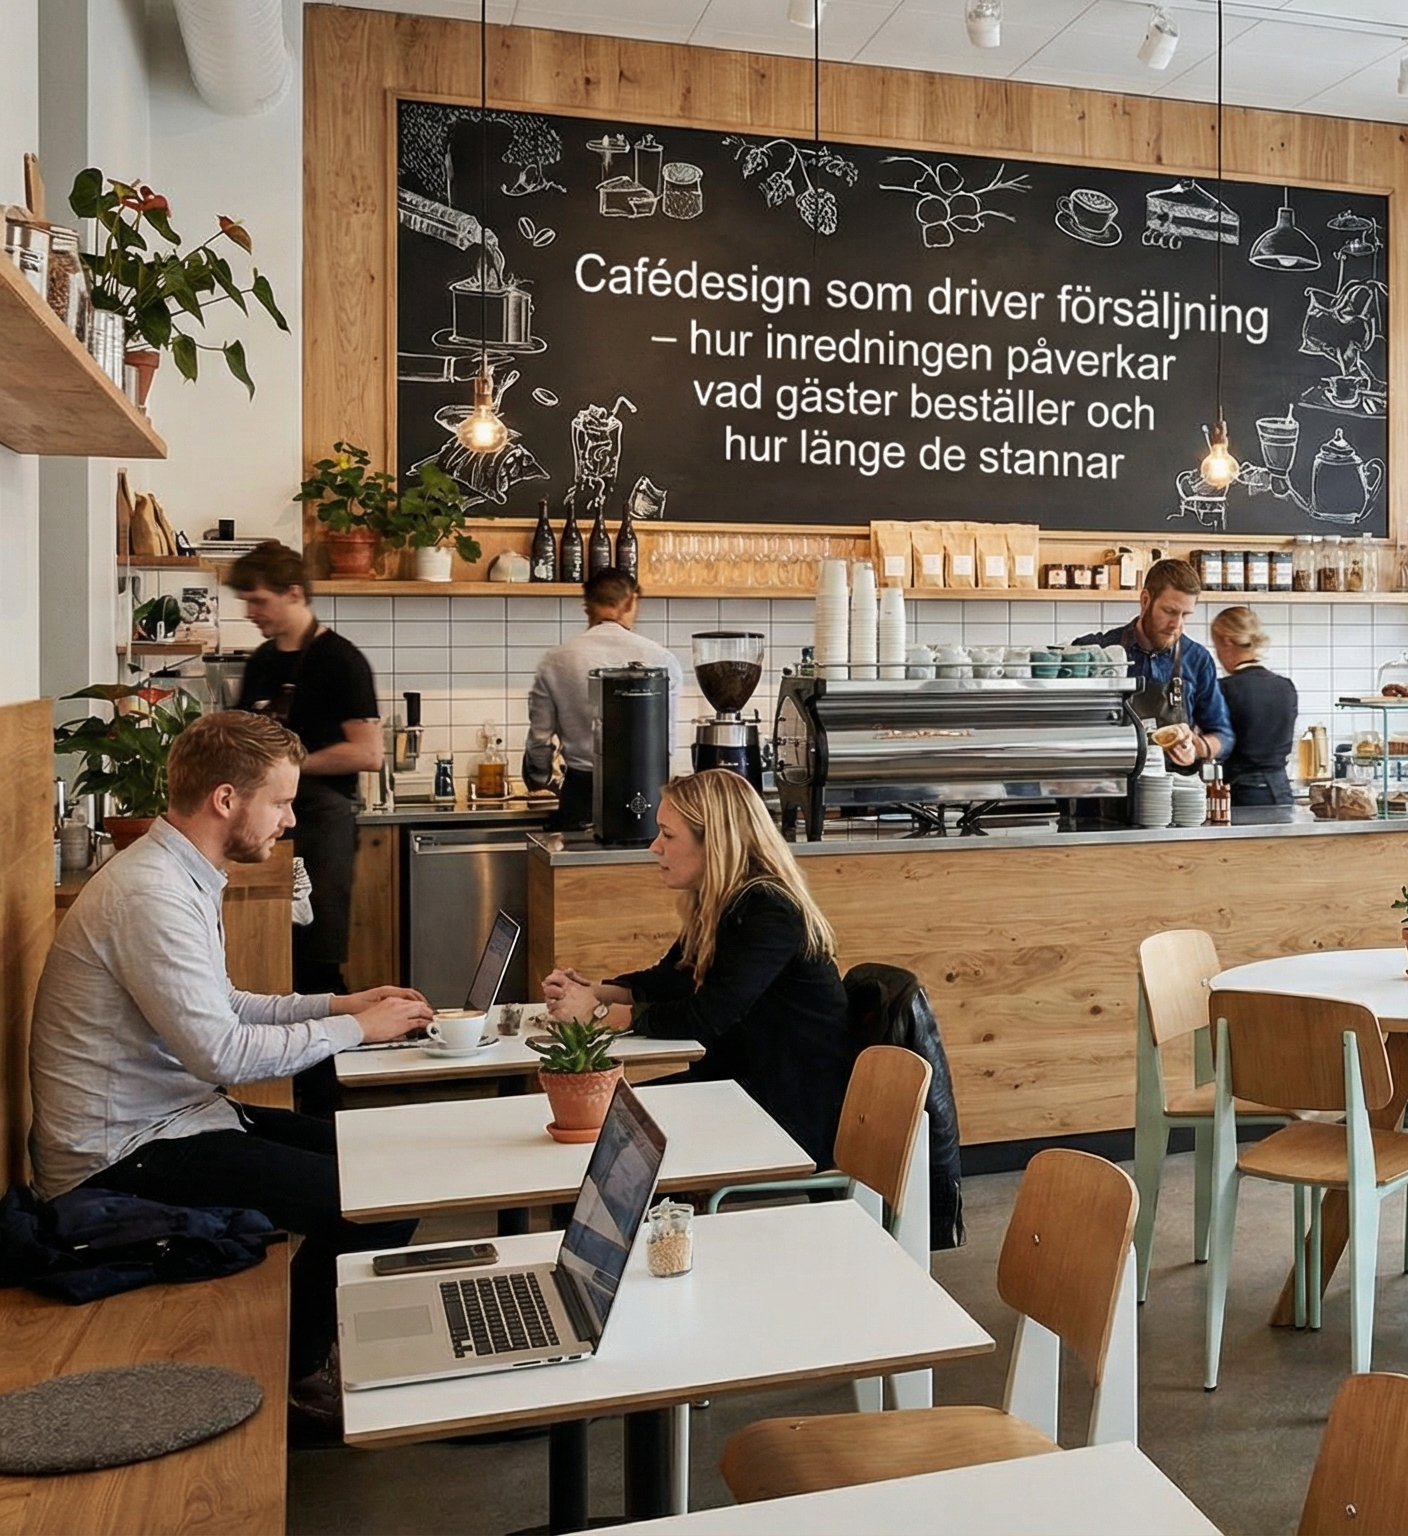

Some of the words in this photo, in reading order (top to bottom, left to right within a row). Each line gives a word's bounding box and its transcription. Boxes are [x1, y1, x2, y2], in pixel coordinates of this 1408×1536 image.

[575, 254, 811, 314] Cafédesign
[827, 280, 912, 313] som
[928, 277, 1046, 321] driver
[1057, 285, 1269, 345] försäljning
[690, 319, 754, 357] hur
[767, 323, 992, 377] inredningen
[1008, 336, 1177, 381] påverkar
[694, 375, 762, 410] vad
[777, 378, 899, 421] gäster
[911, 382, 1076, 426] beställer
[1088, 396, 1155, 431] och
[725, 426, 788, 463] hur
[800, 429, 906, 477] länge
[919, 436, 966, 472] de
[980, 442, 1126, 480] stannar
